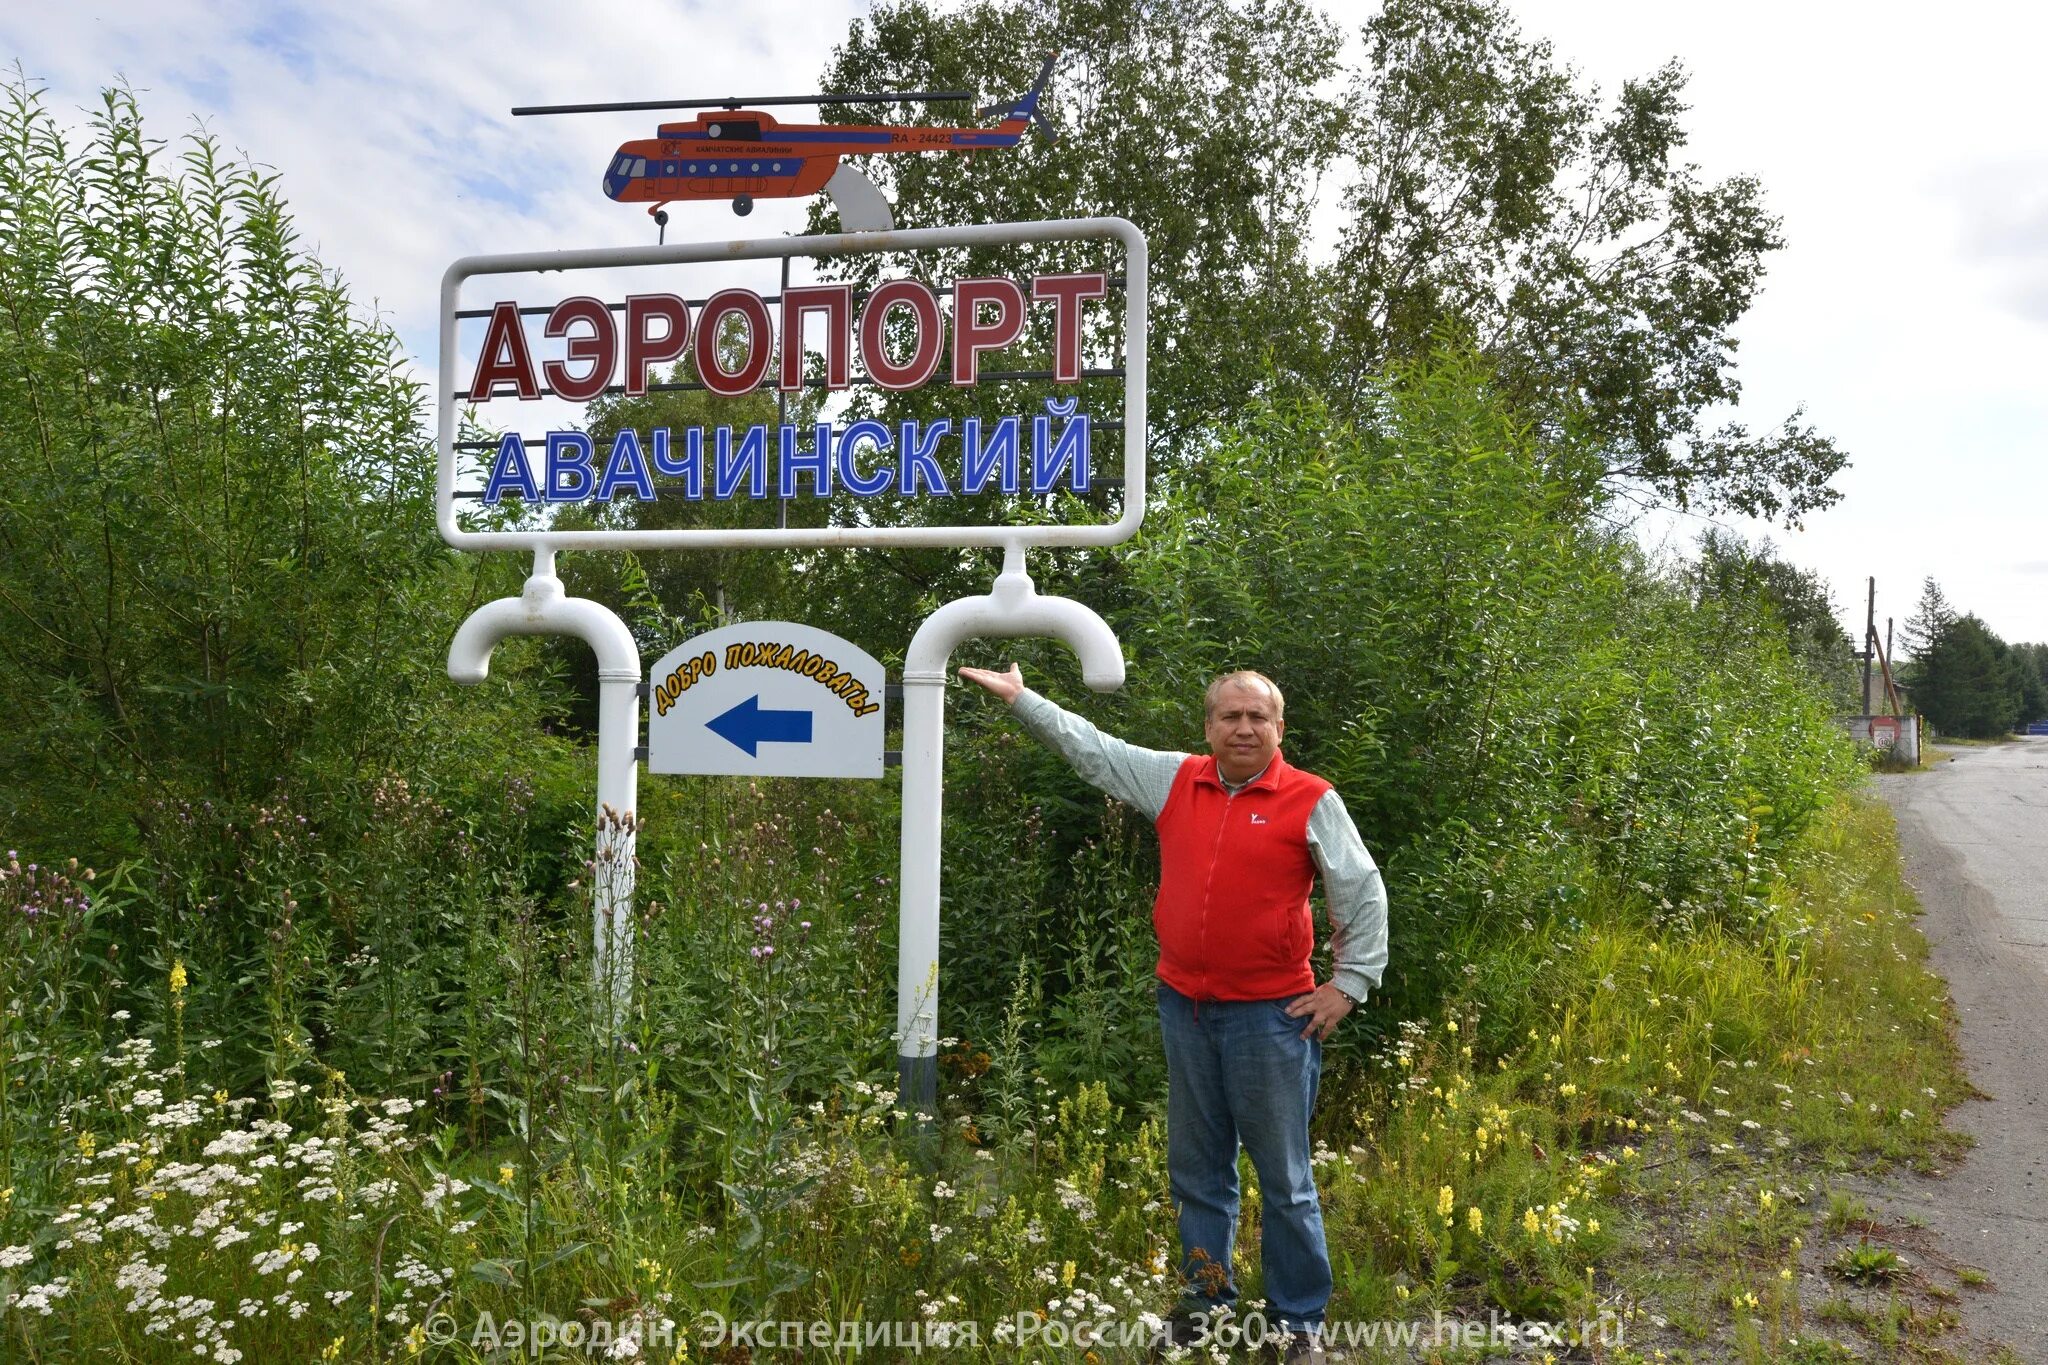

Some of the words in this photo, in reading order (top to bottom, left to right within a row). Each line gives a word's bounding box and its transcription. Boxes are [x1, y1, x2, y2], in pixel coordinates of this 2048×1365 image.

[746, 146, 793, 154] АВИАЛИНИИ
[891, 133, 908, 143] RA
[918, 133, 952, 143] 24423
[468, 272, 1108, 402] АЭРОПОРТ
[484, 396, 1092, 503] АВАЧИНСКИЙ
[655, 651, 717, 716] ДОБРО
[725, 641, 880, 718] ПОЖАЛОВАТЬ!
